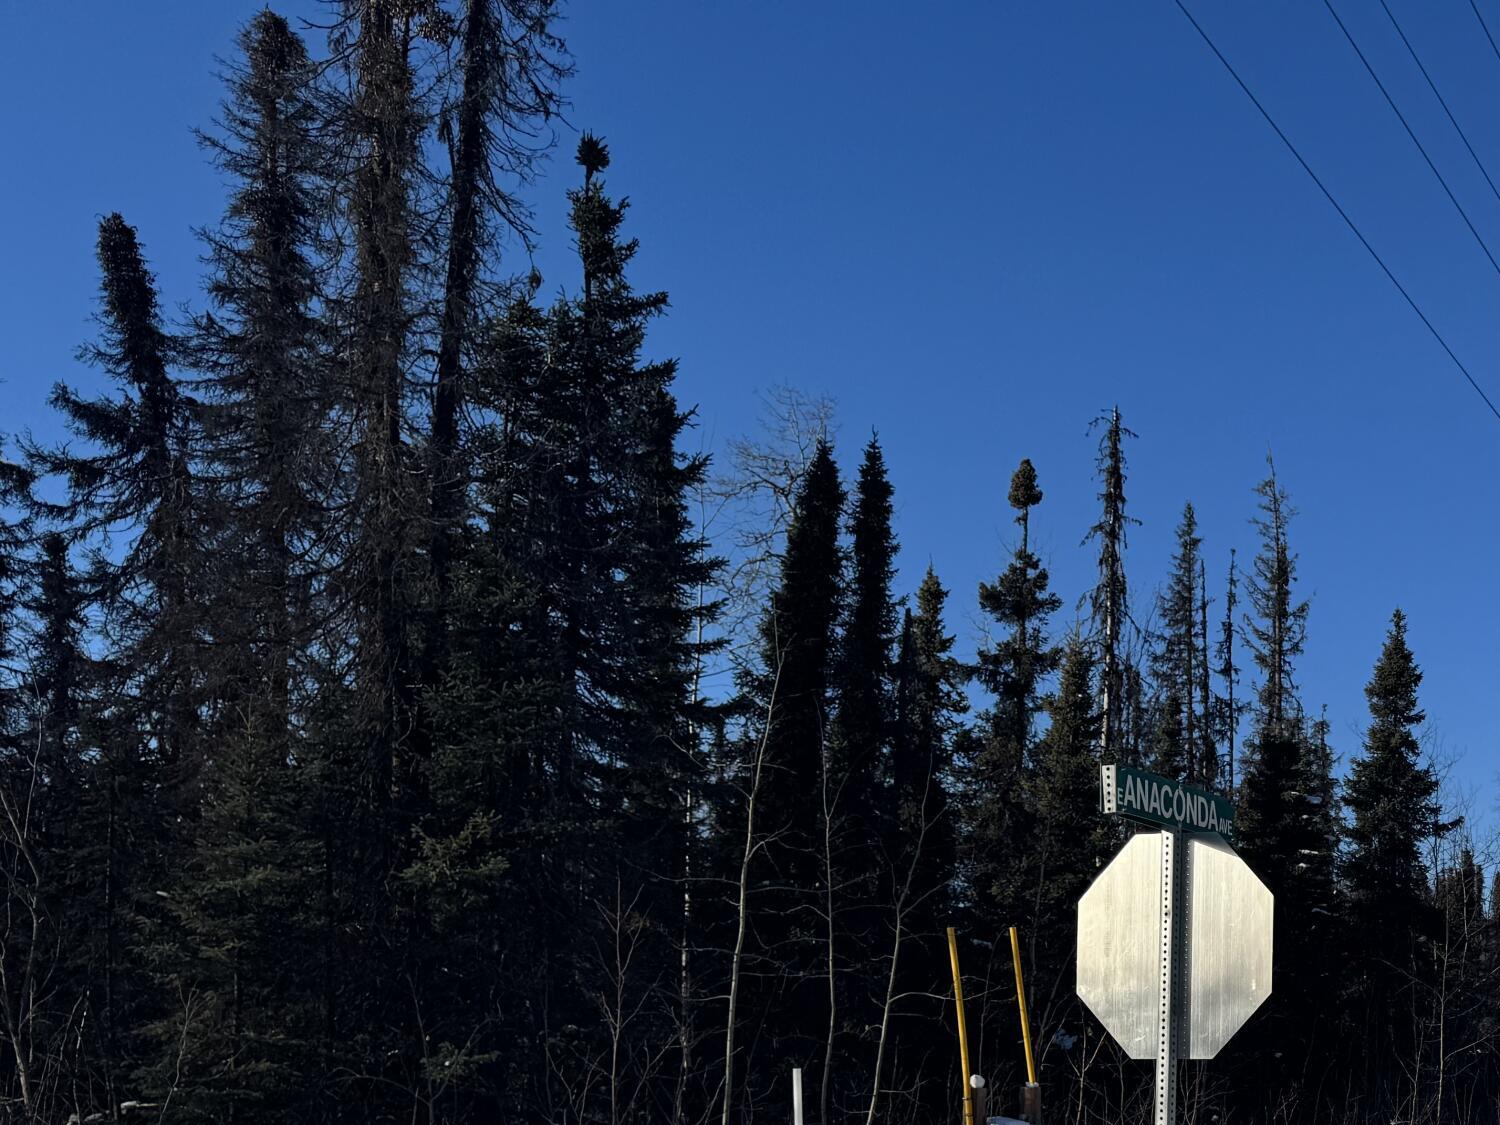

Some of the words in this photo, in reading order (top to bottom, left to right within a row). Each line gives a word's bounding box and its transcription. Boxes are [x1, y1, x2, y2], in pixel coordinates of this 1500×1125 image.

[1117, 787, 1124, 805] E
[1124, 774, 1219, 831] ANACONDA
[1219, 818, 1233, 836] AVE
